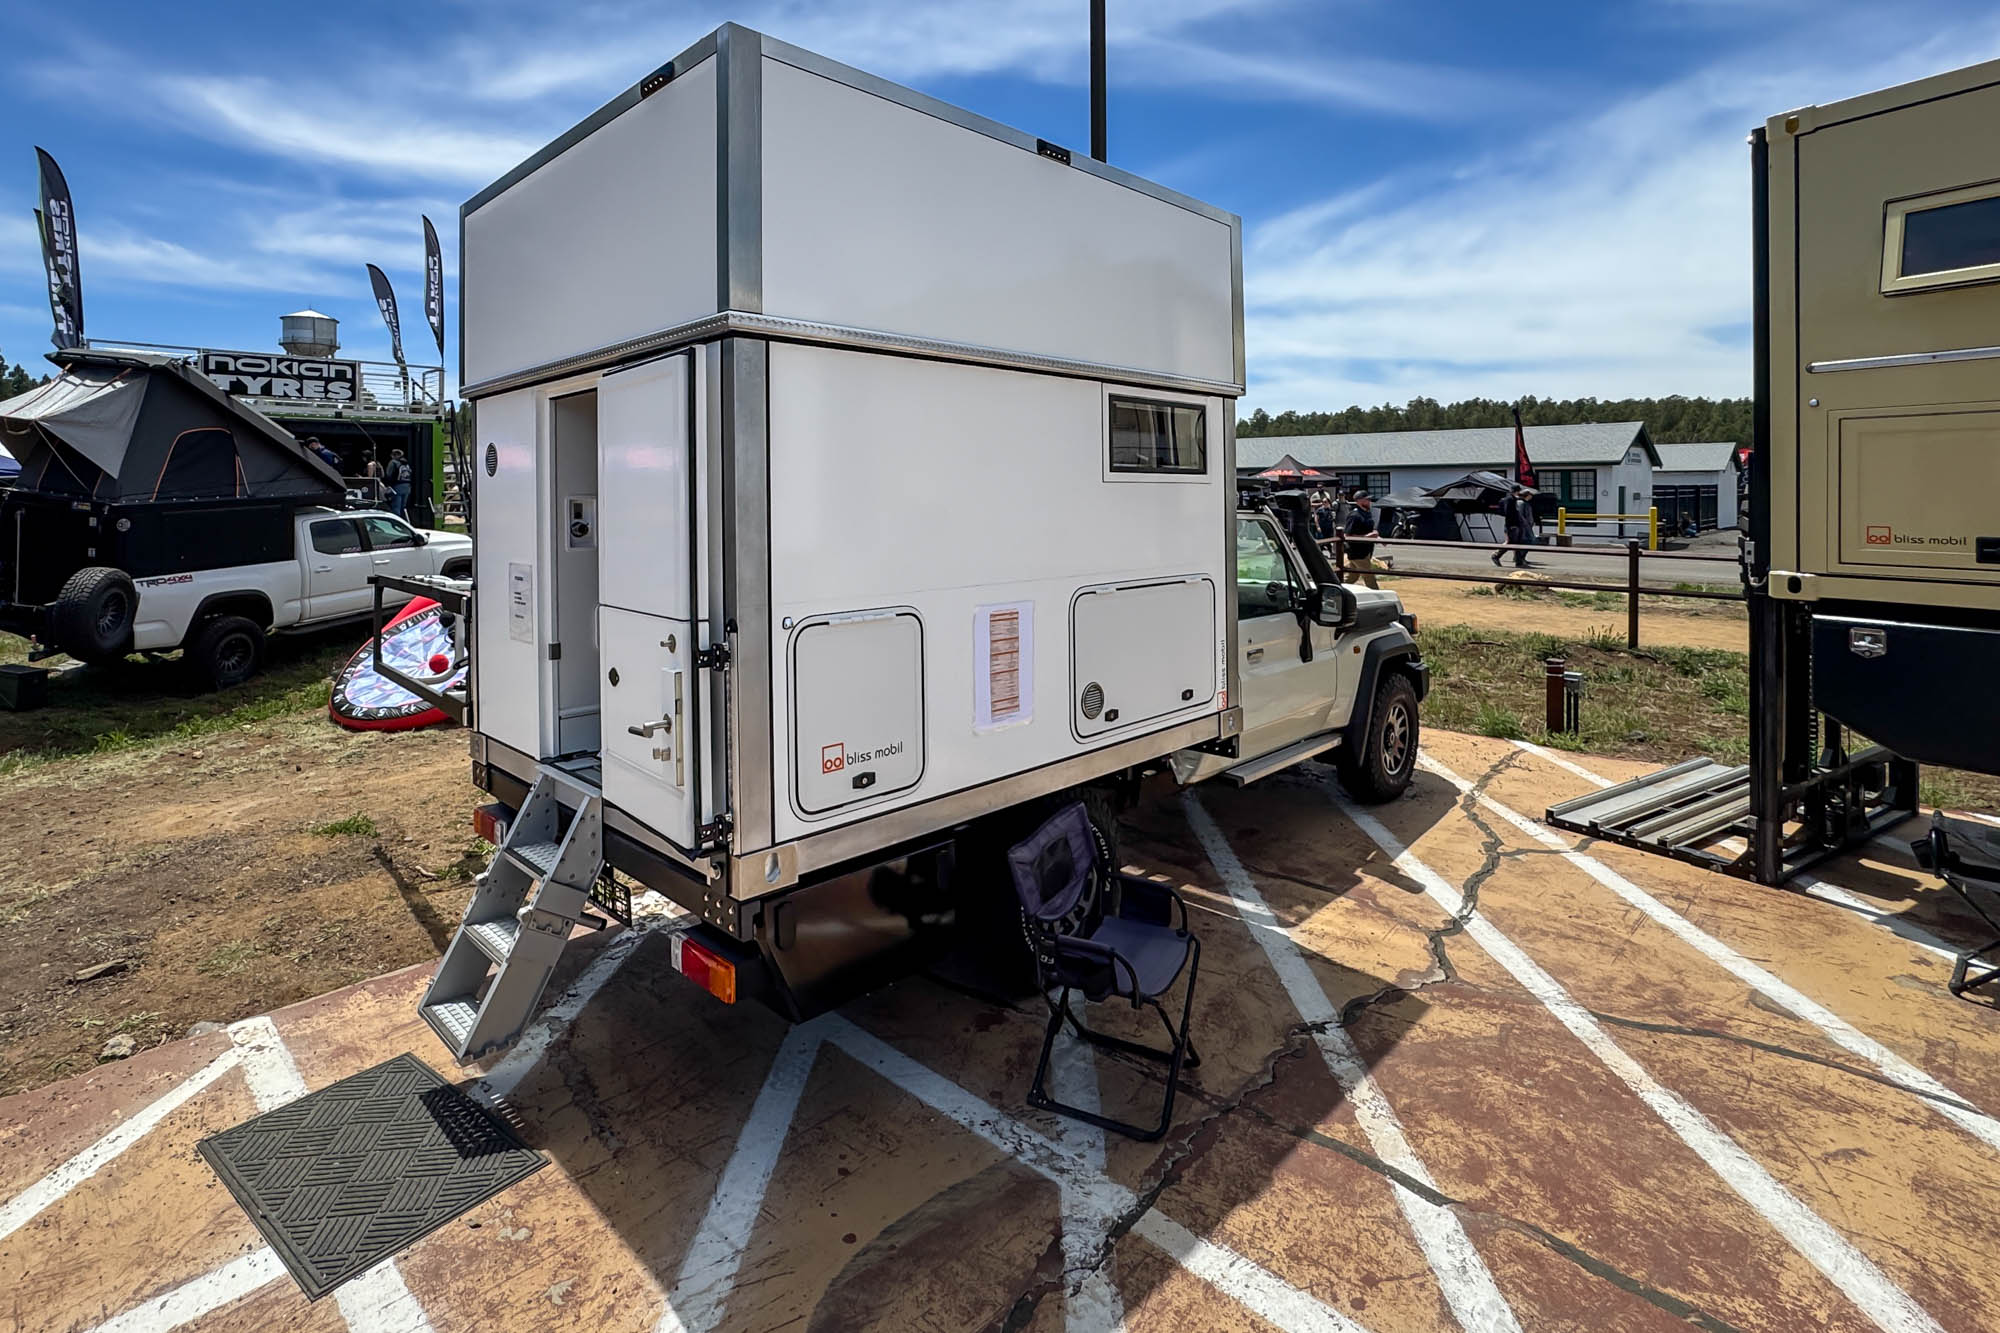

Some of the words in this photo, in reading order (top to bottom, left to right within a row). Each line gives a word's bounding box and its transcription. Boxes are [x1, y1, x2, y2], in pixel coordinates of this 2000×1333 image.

[208, 373, 352, 399] TYRES
[1893, 534, 1925, 544] bliss
[1928, 536, 1967, 546] mobil
[351, 706, 368, 717] 20
[377, 707, 388, 717] 5
[846, 752, 872, 766] bliss
[875, 741, 903, 759] mobil
